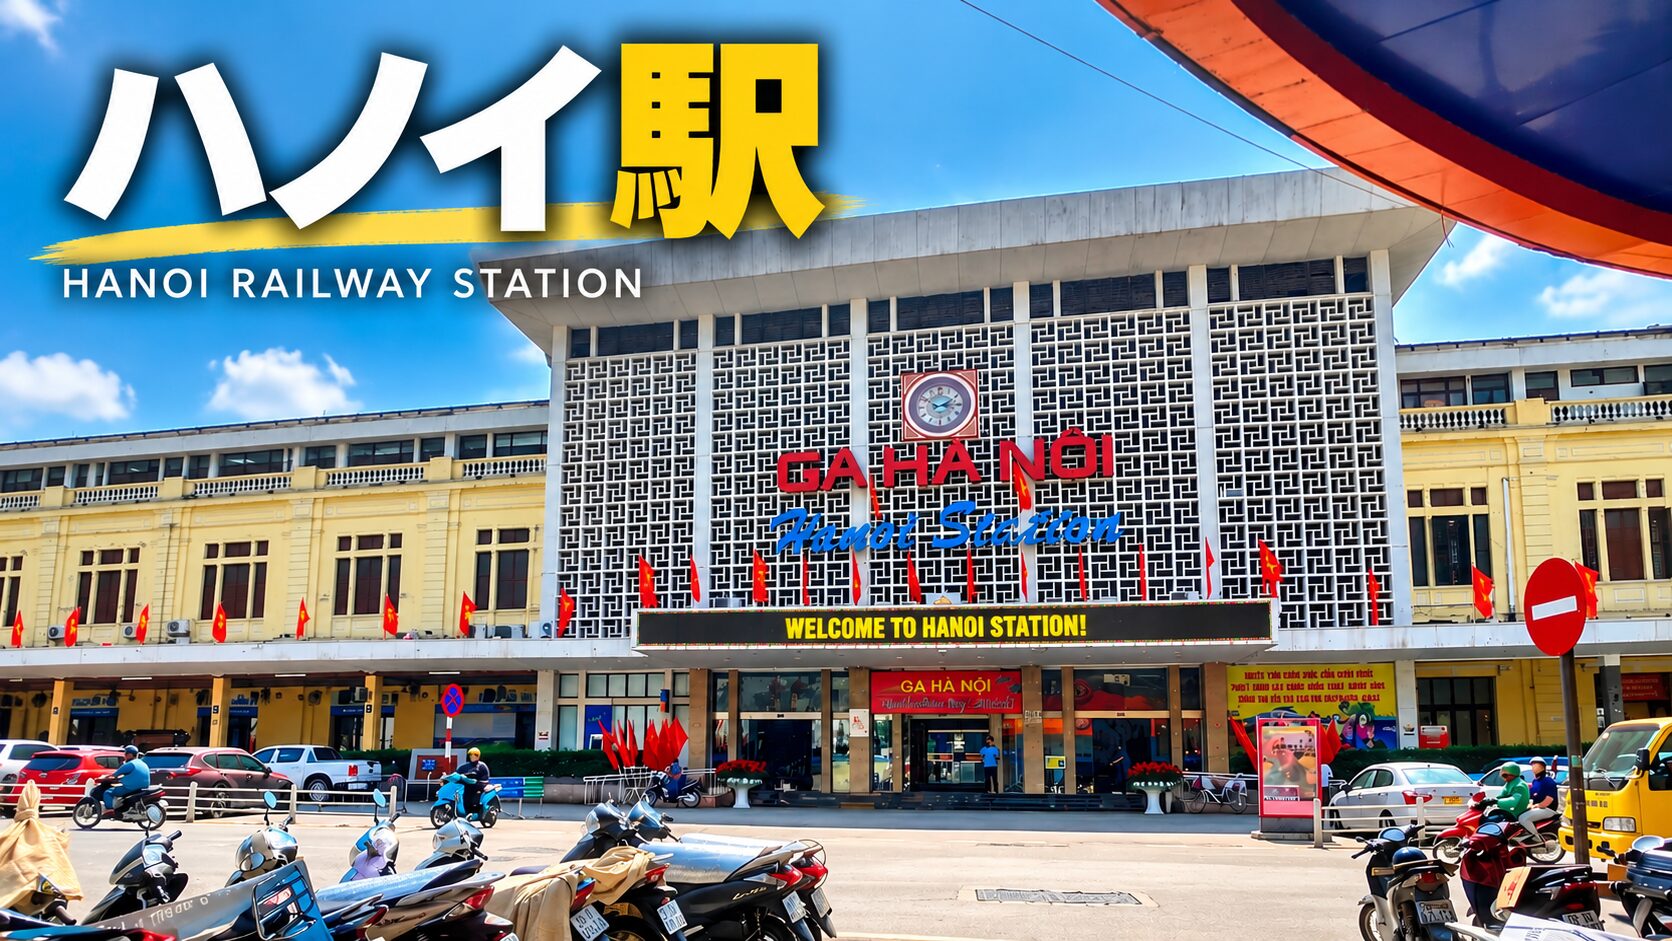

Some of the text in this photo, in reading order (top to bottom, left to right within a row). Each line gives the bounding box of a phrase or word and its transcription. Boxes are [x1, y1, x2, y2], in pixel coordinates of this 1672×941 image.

[777, 446, 868, 493] GA
[770, 500, 1124, 555] Hanoi Station
[785, 614, 1087, 640] WELCOME TO HANOI STATION!
[900, 679, 926, 693] GA
